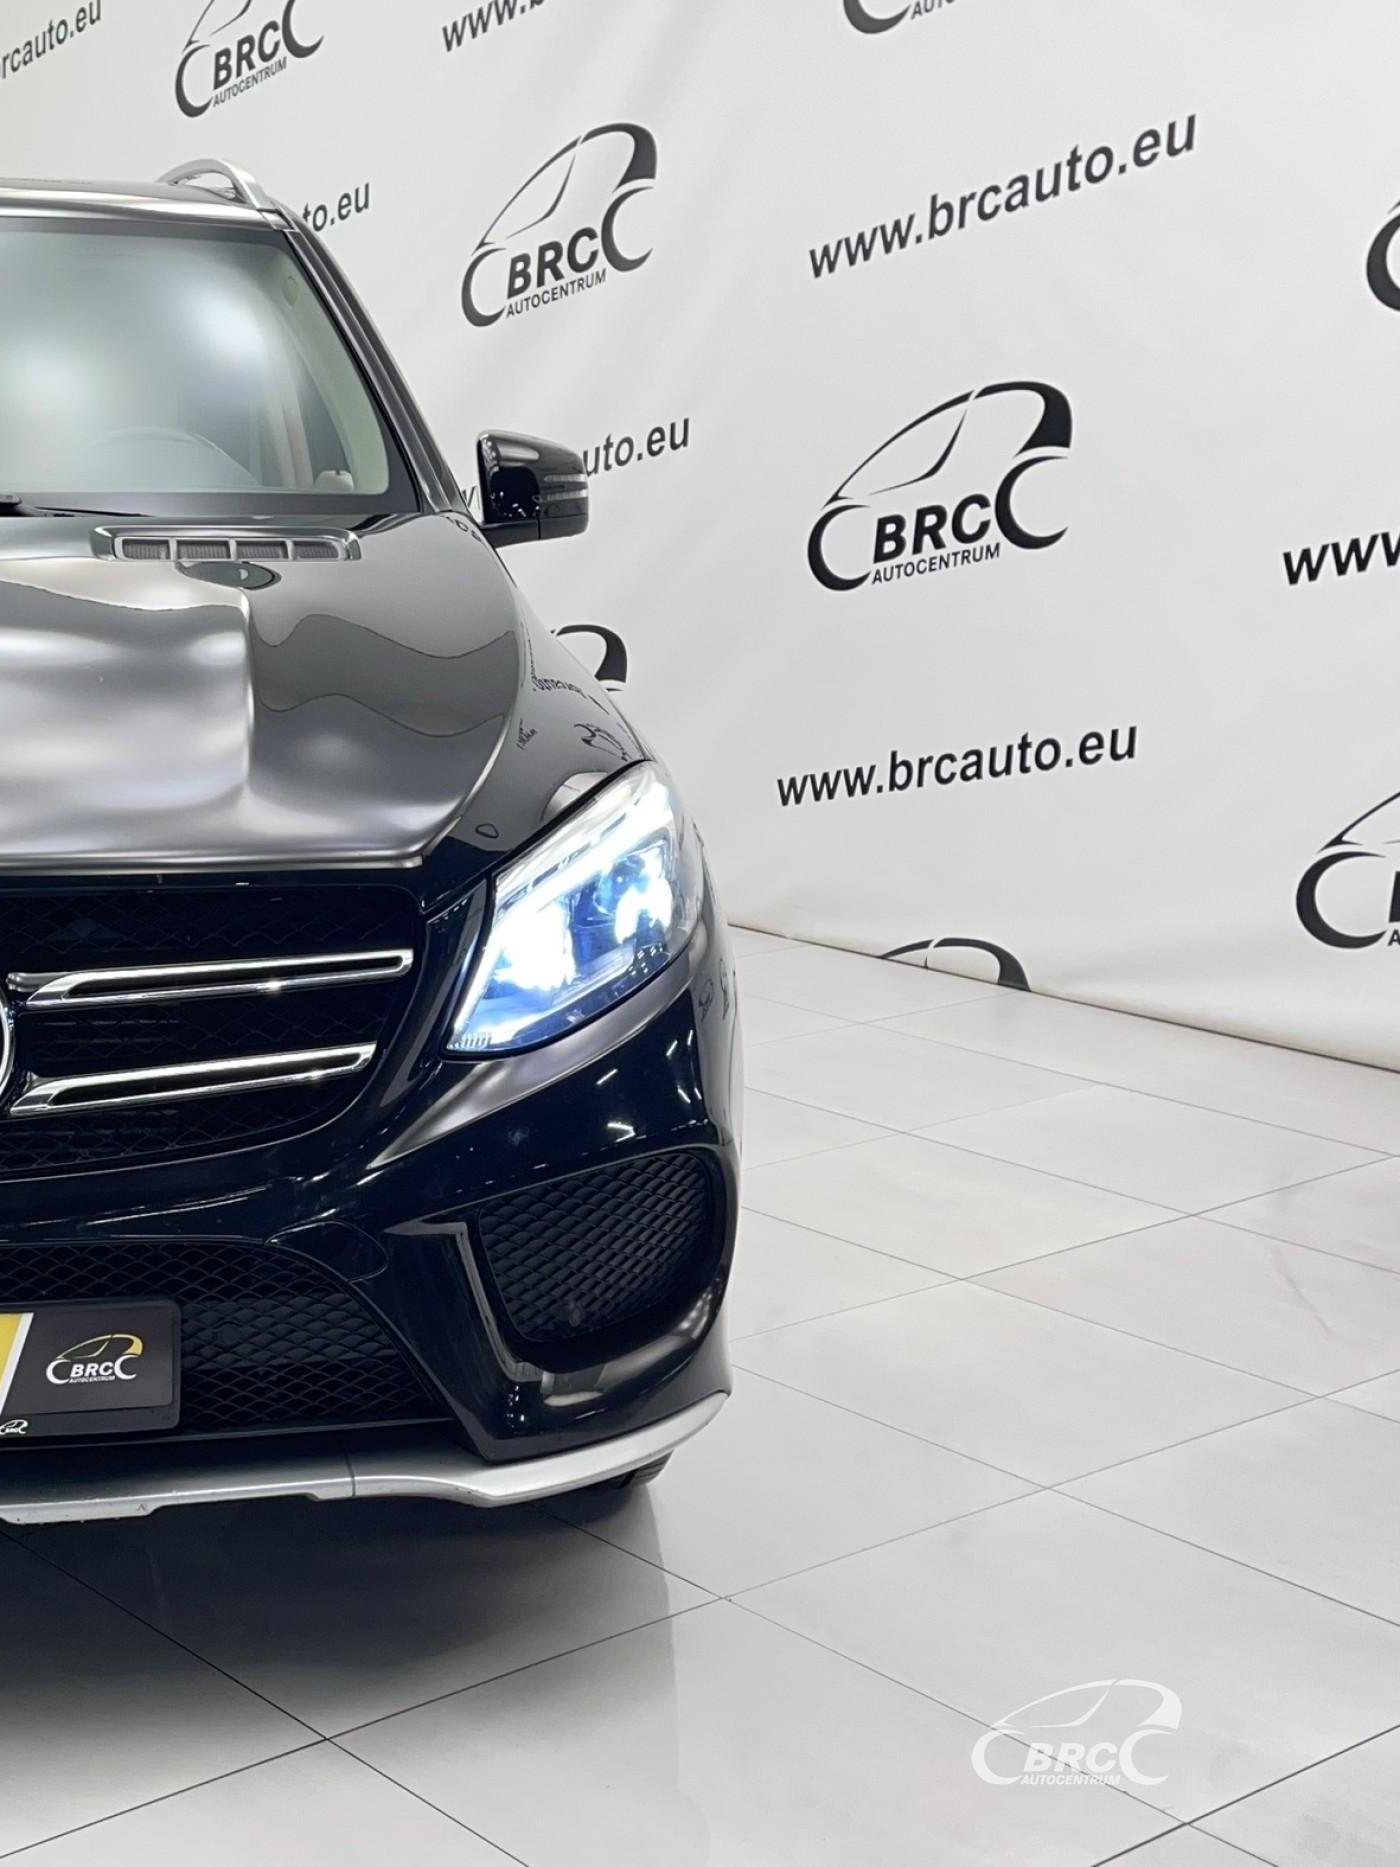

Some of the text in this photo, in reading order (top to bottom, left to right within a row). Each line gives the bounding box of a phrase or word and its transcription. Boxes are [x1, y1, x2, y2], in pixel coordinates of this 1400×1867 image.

[212, 56, 288, 108] AUTOCENTRUM
[213, 20, 281, 91] BRC
[809, 114, 1196, 278] www.brcauto.eu
[505, 267, 607, 319] AUTOCENTRUM
[506, 226, 599, 300] BRC
[583, 418, 690, 477] uto.eu
[872, 493, 992, 565] BRC
[871, 541, 1001, 585] AUTOCENTRUM
[776, 725, 1137, 807] www.brcauto.eu
[70, 1361, 115, 1378] BRC
